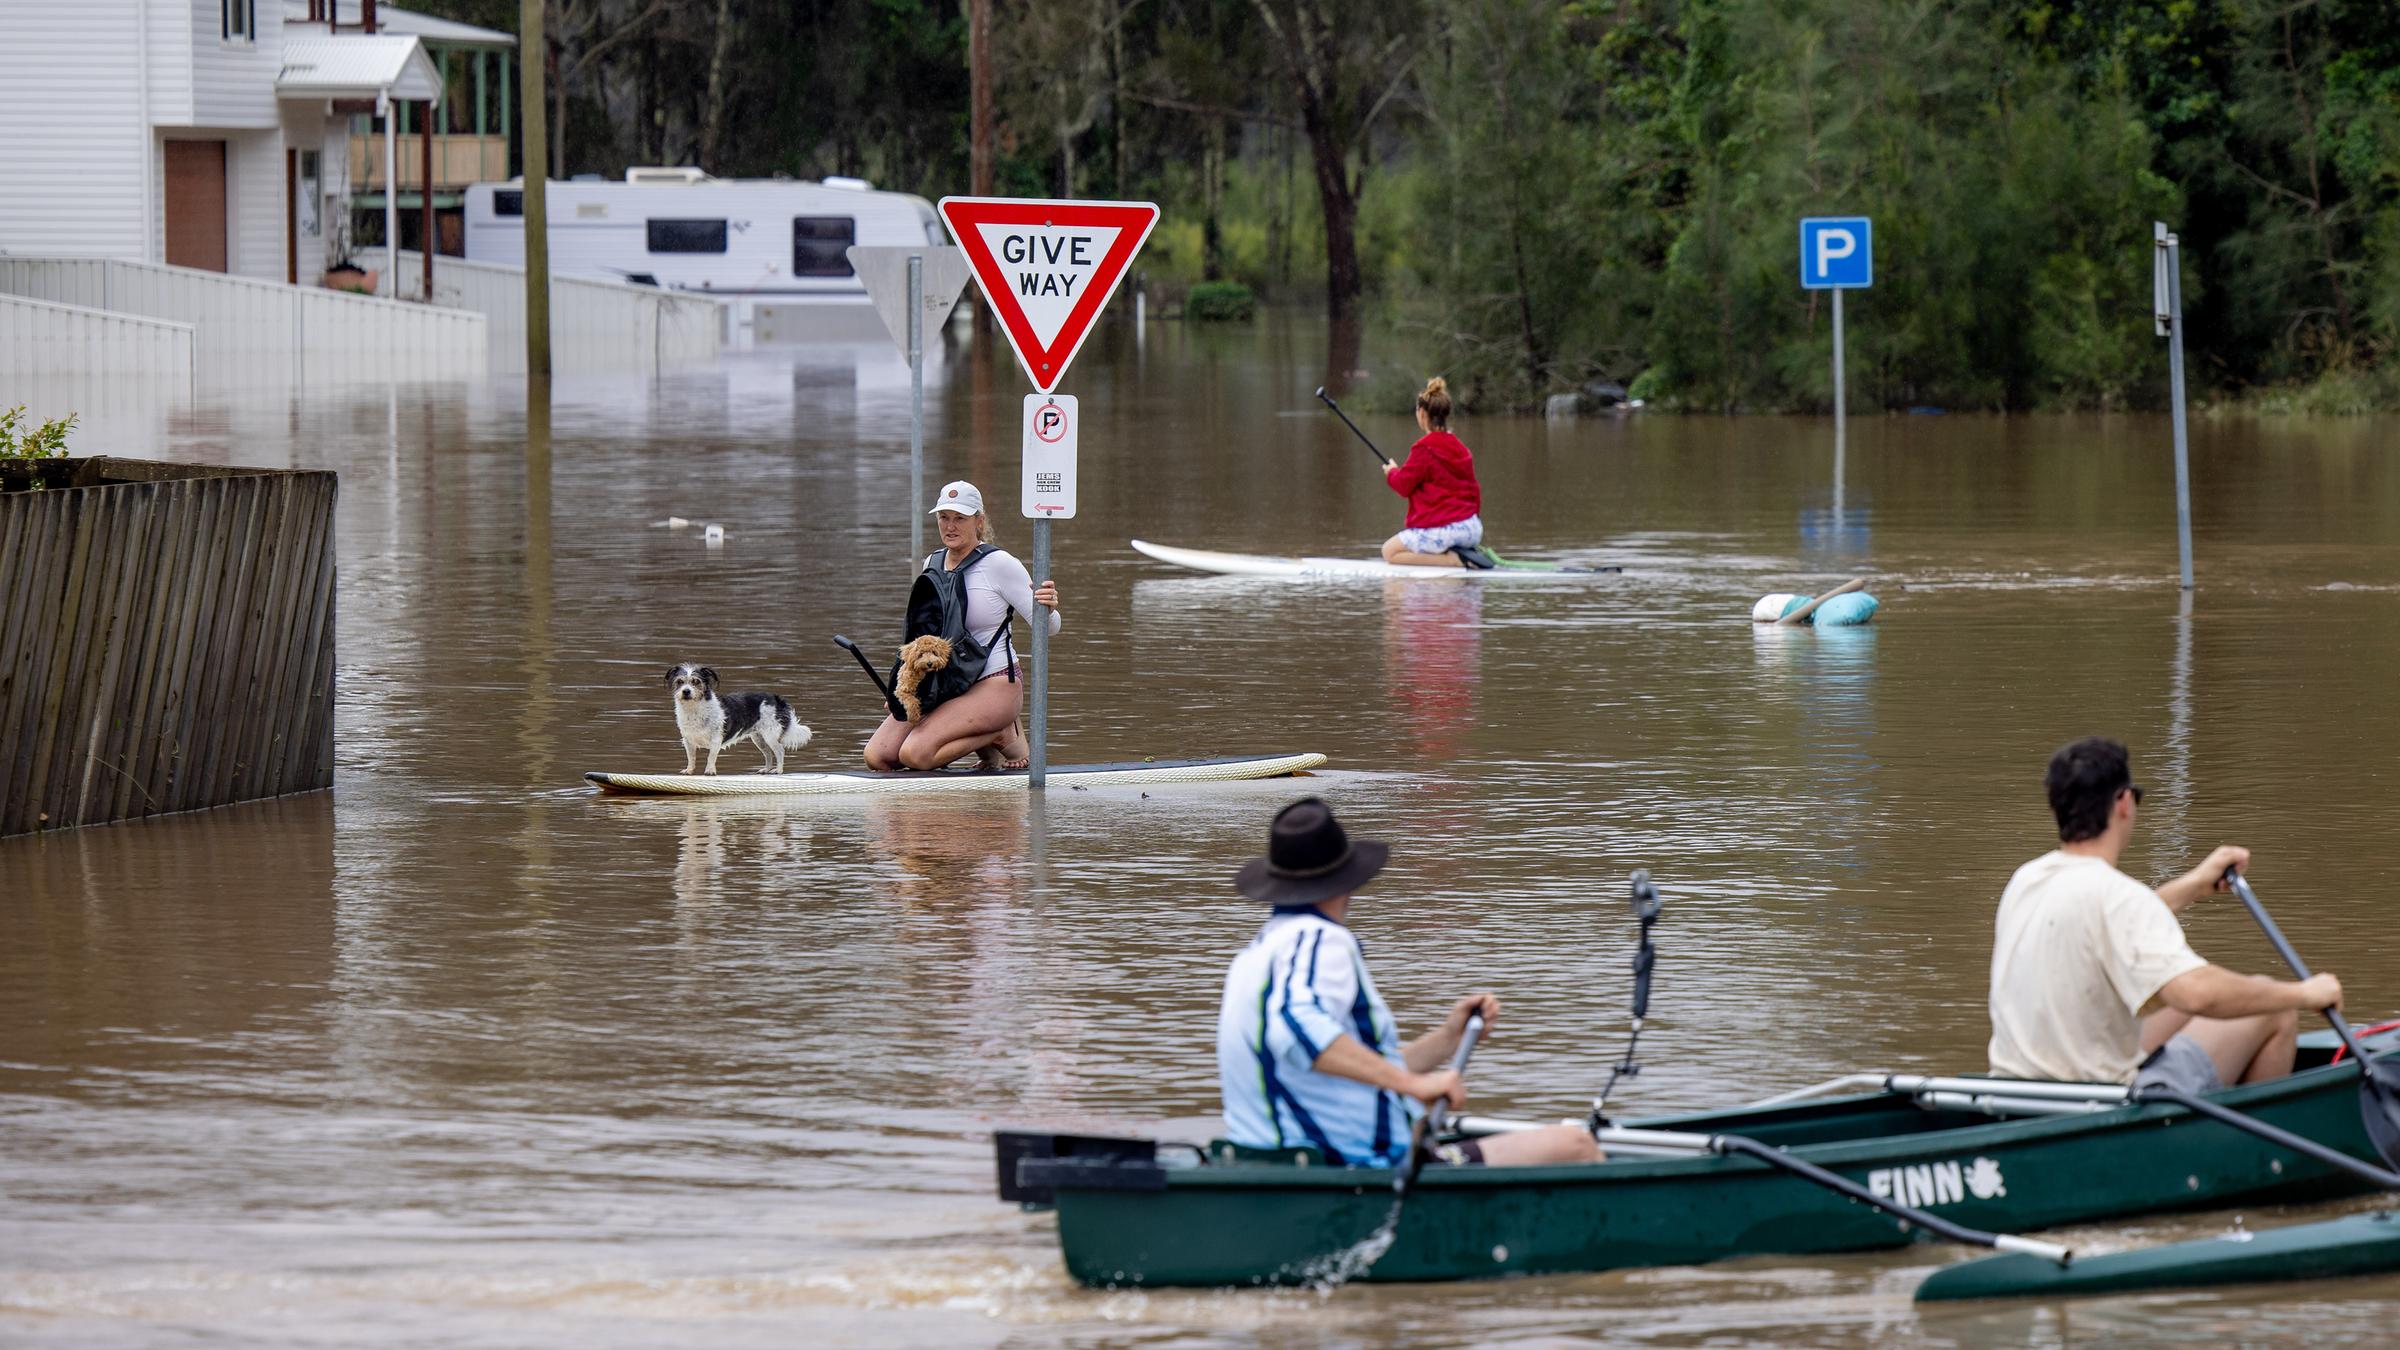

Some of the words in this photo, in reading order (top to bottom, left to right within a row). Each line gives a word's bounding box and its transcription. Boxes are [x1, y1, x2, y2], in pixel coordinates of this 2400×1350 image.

[1003, 235, 1092, 265] GIVE
[1817, 228, 1856, 278] P
[1020, 272, 1077, 297] WAY
[1043, 412, 1060, 435] P
[1868, 1160, 1965, 1209] FINN
